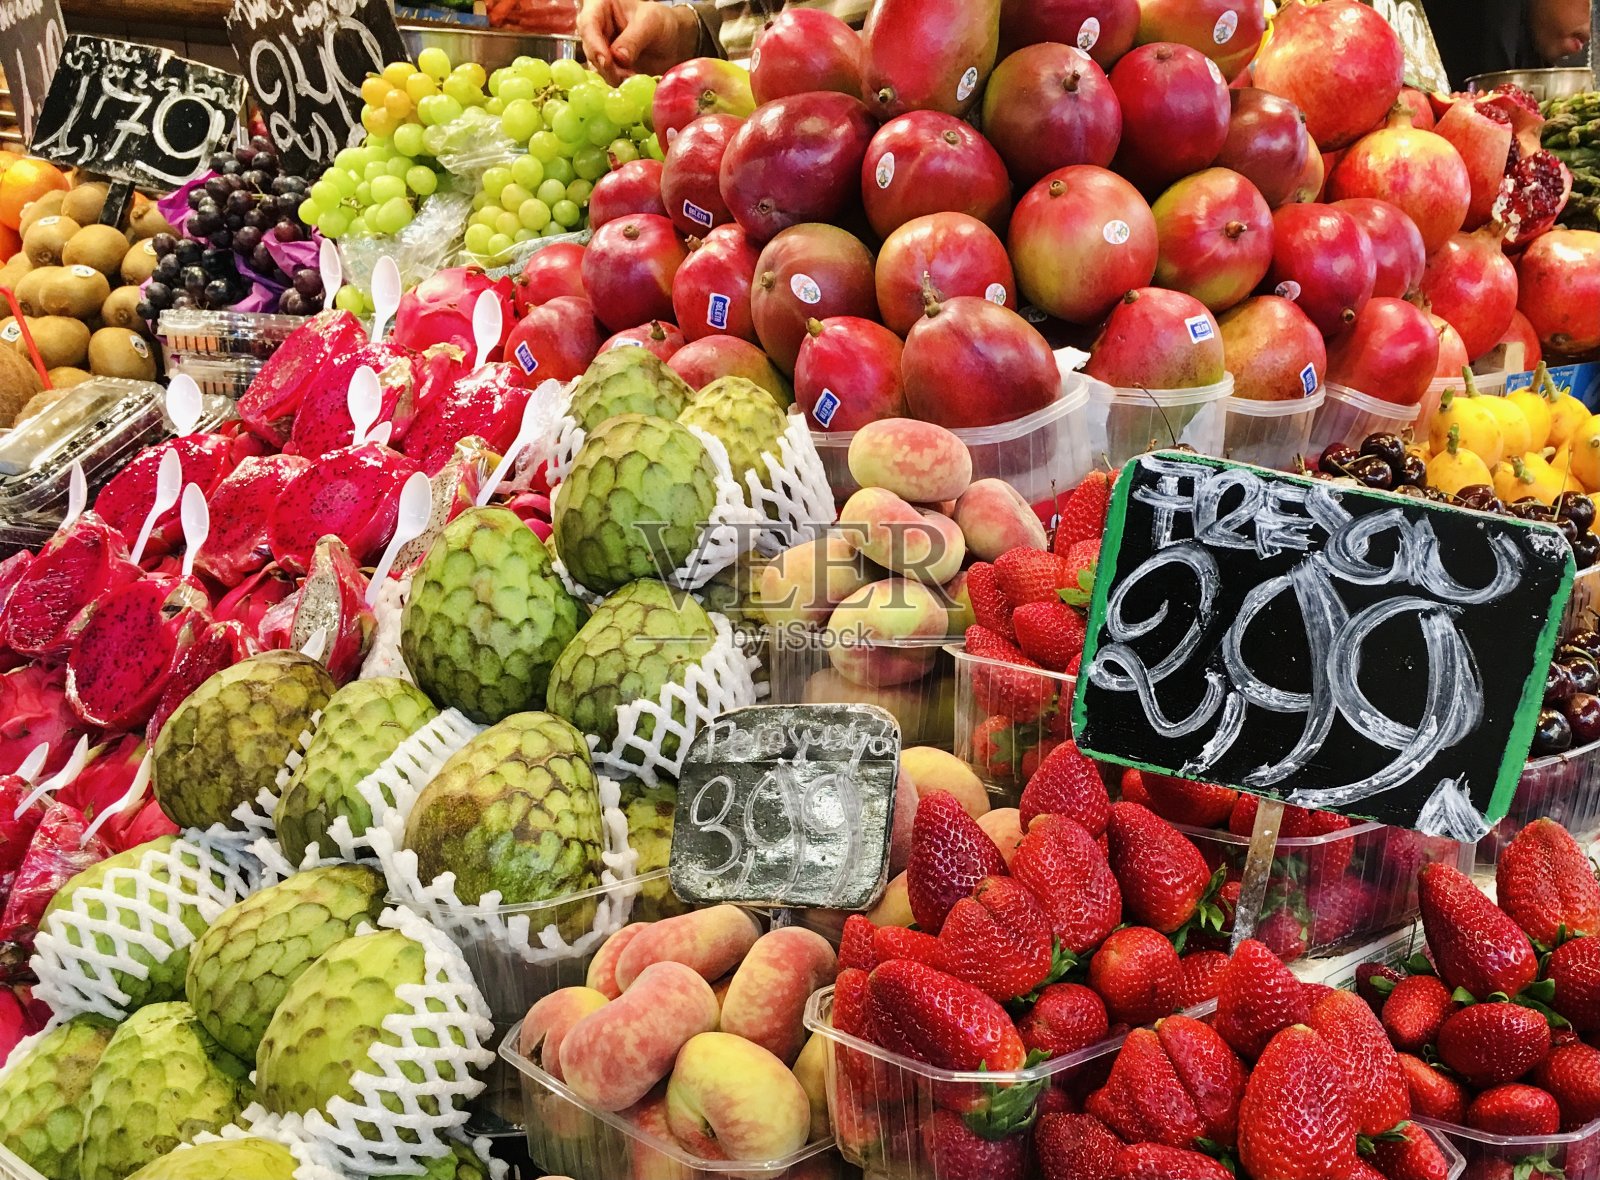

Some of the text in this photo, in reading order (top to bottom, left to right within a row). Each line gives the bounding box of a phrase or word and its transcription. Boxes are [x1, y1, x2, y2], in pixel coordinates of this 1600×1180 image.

[31, 72, 226, 187] 1,79
[1086, 540, 1486, 809] 2,99
[690, 757, 864, 902] 3,99
